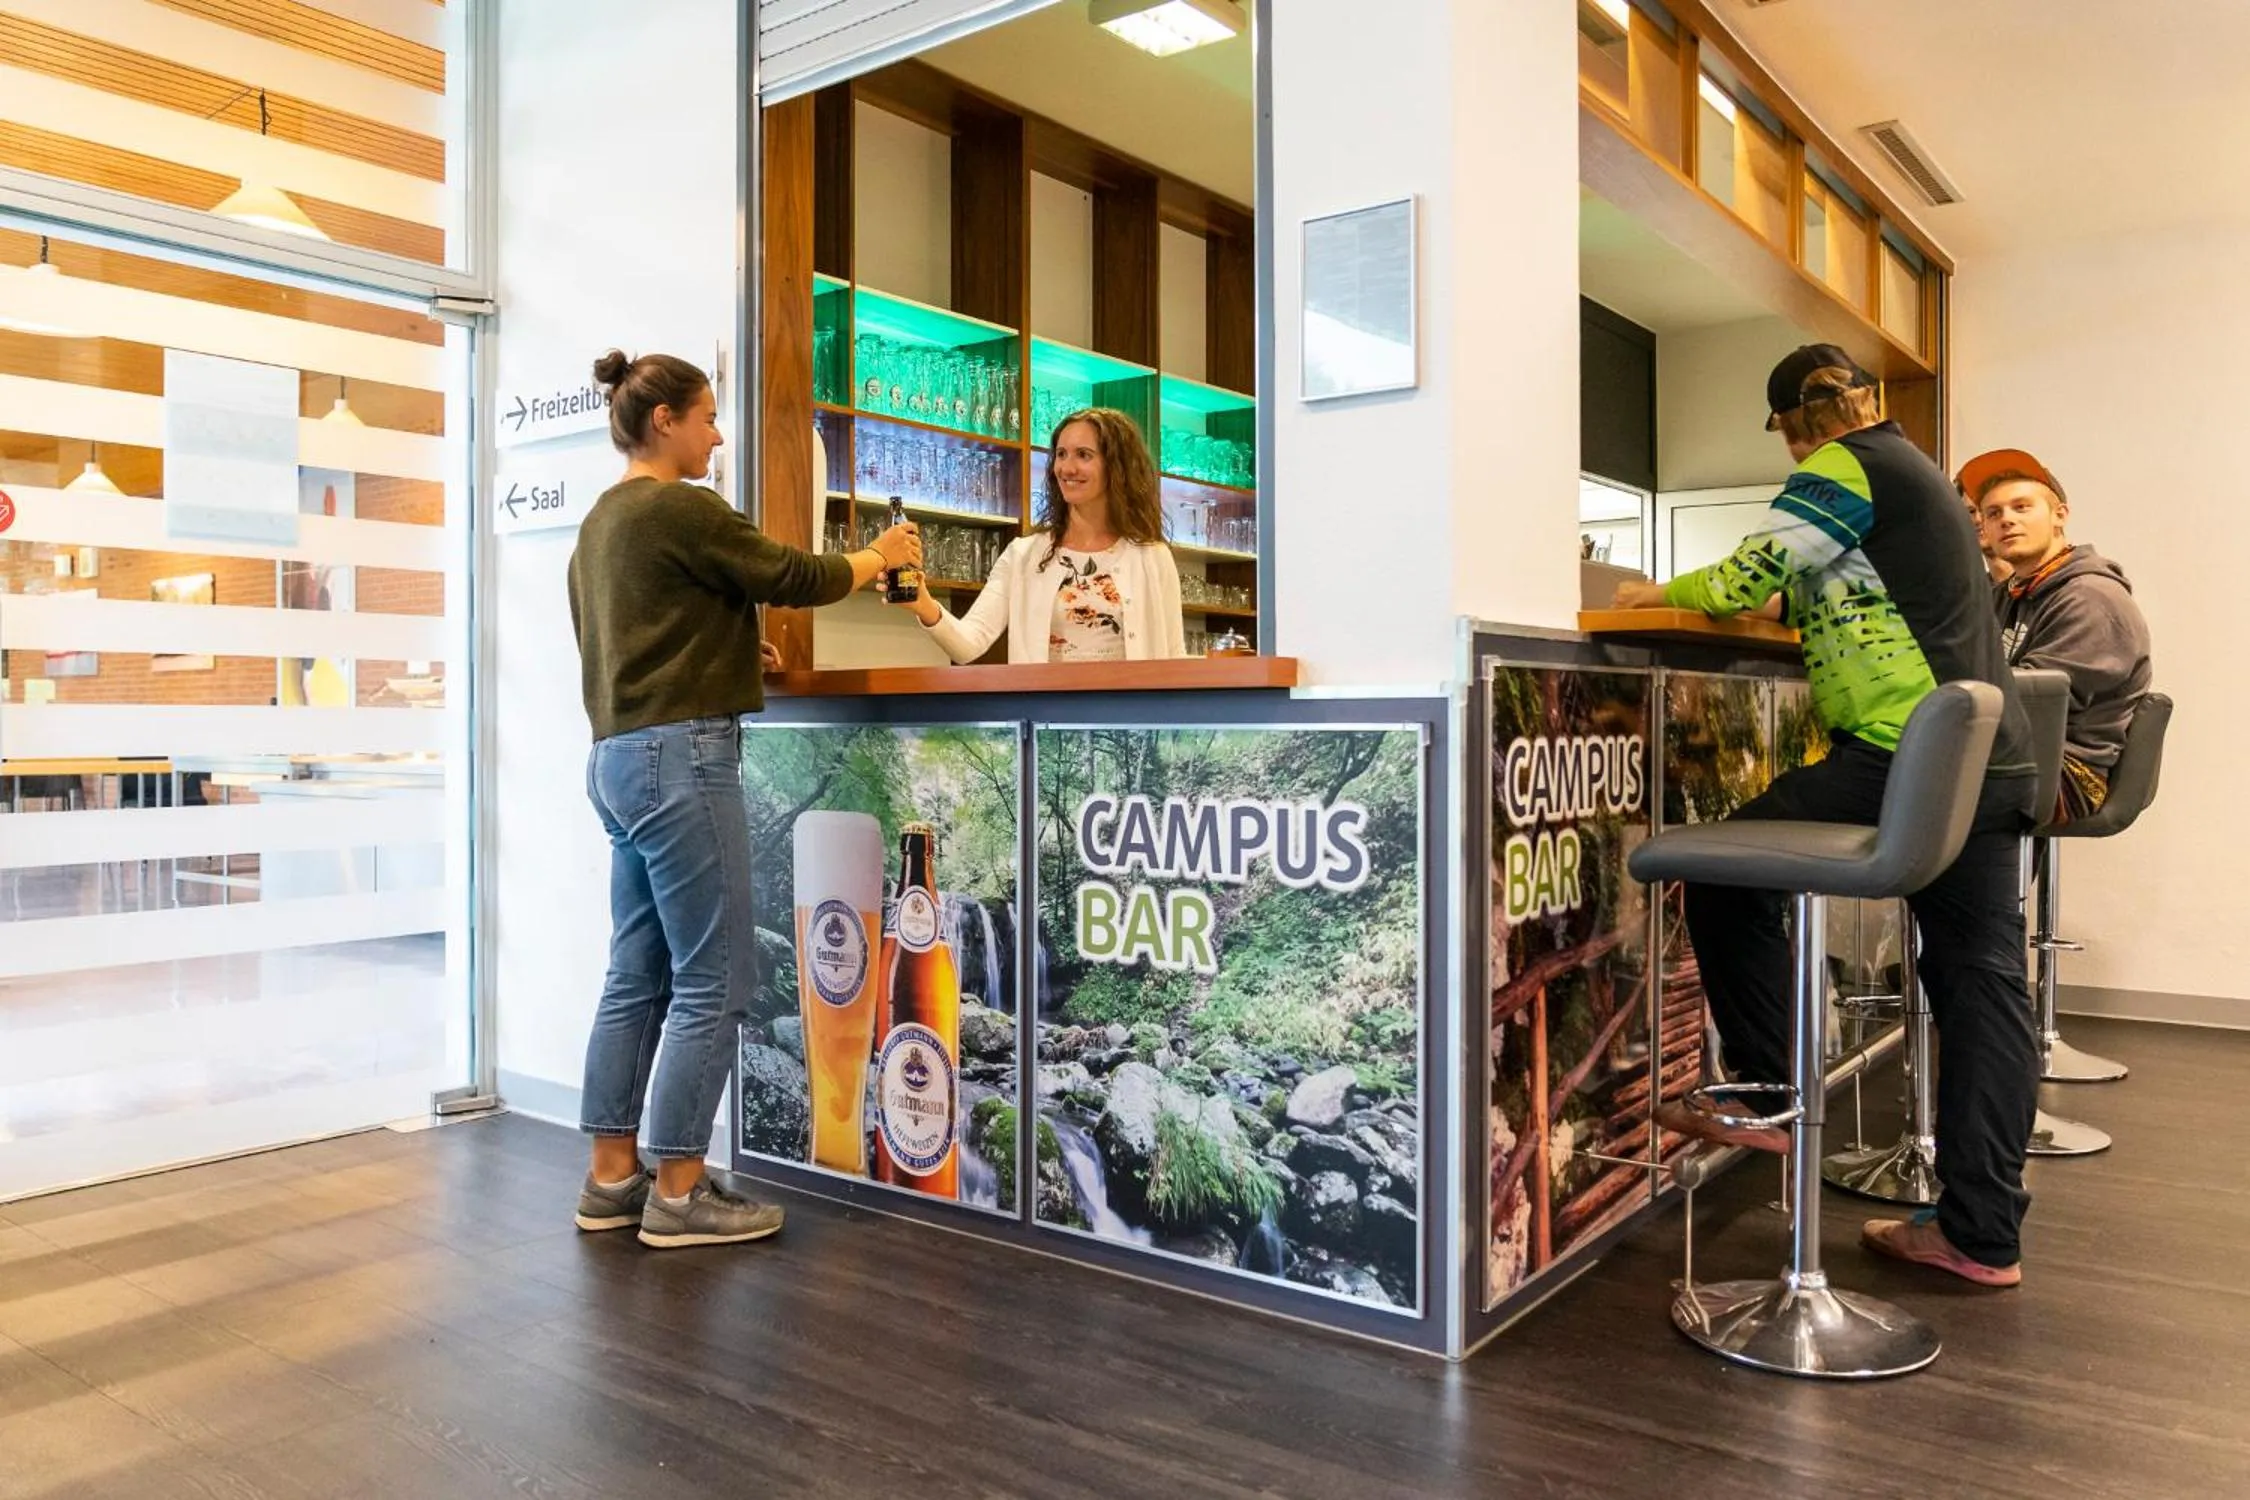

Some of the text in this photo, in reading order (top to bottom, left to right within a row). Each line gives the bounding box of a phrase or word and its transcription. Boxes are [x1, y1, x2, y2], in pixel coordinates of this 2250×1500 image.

[531, 481, 565, 511] Saal
[1506, 738, 1643, 819] CAMPUS
[1080, 798, 1365, 885] CAMPUS
[1506, 835, 1581, 917] BAR
[1081, 887, 1212, 966] BAR
